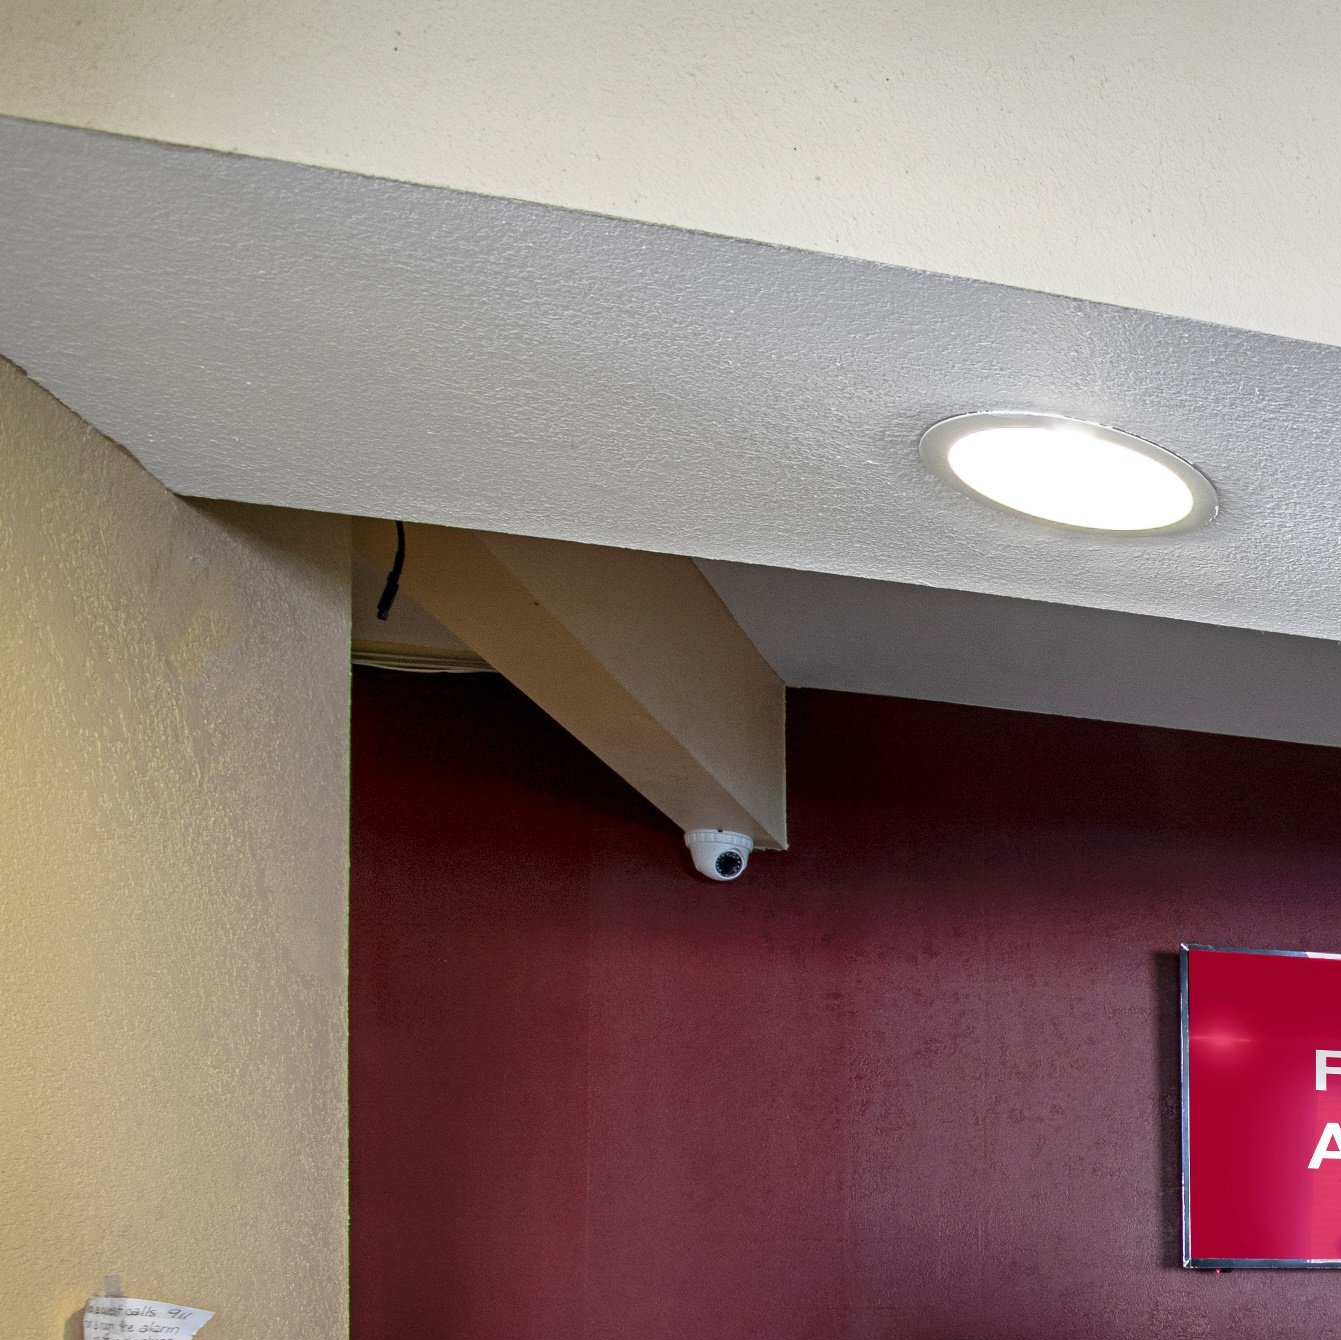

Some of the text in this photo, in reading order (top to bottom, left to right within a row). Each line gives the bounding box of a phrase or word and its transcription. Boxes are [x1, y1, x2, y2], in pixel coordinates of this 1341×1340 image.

[125, 1306, 156, 1317] calls
[168, 1308, 192, 1319] 911
[139, 1322, 180, 1334] alarm
